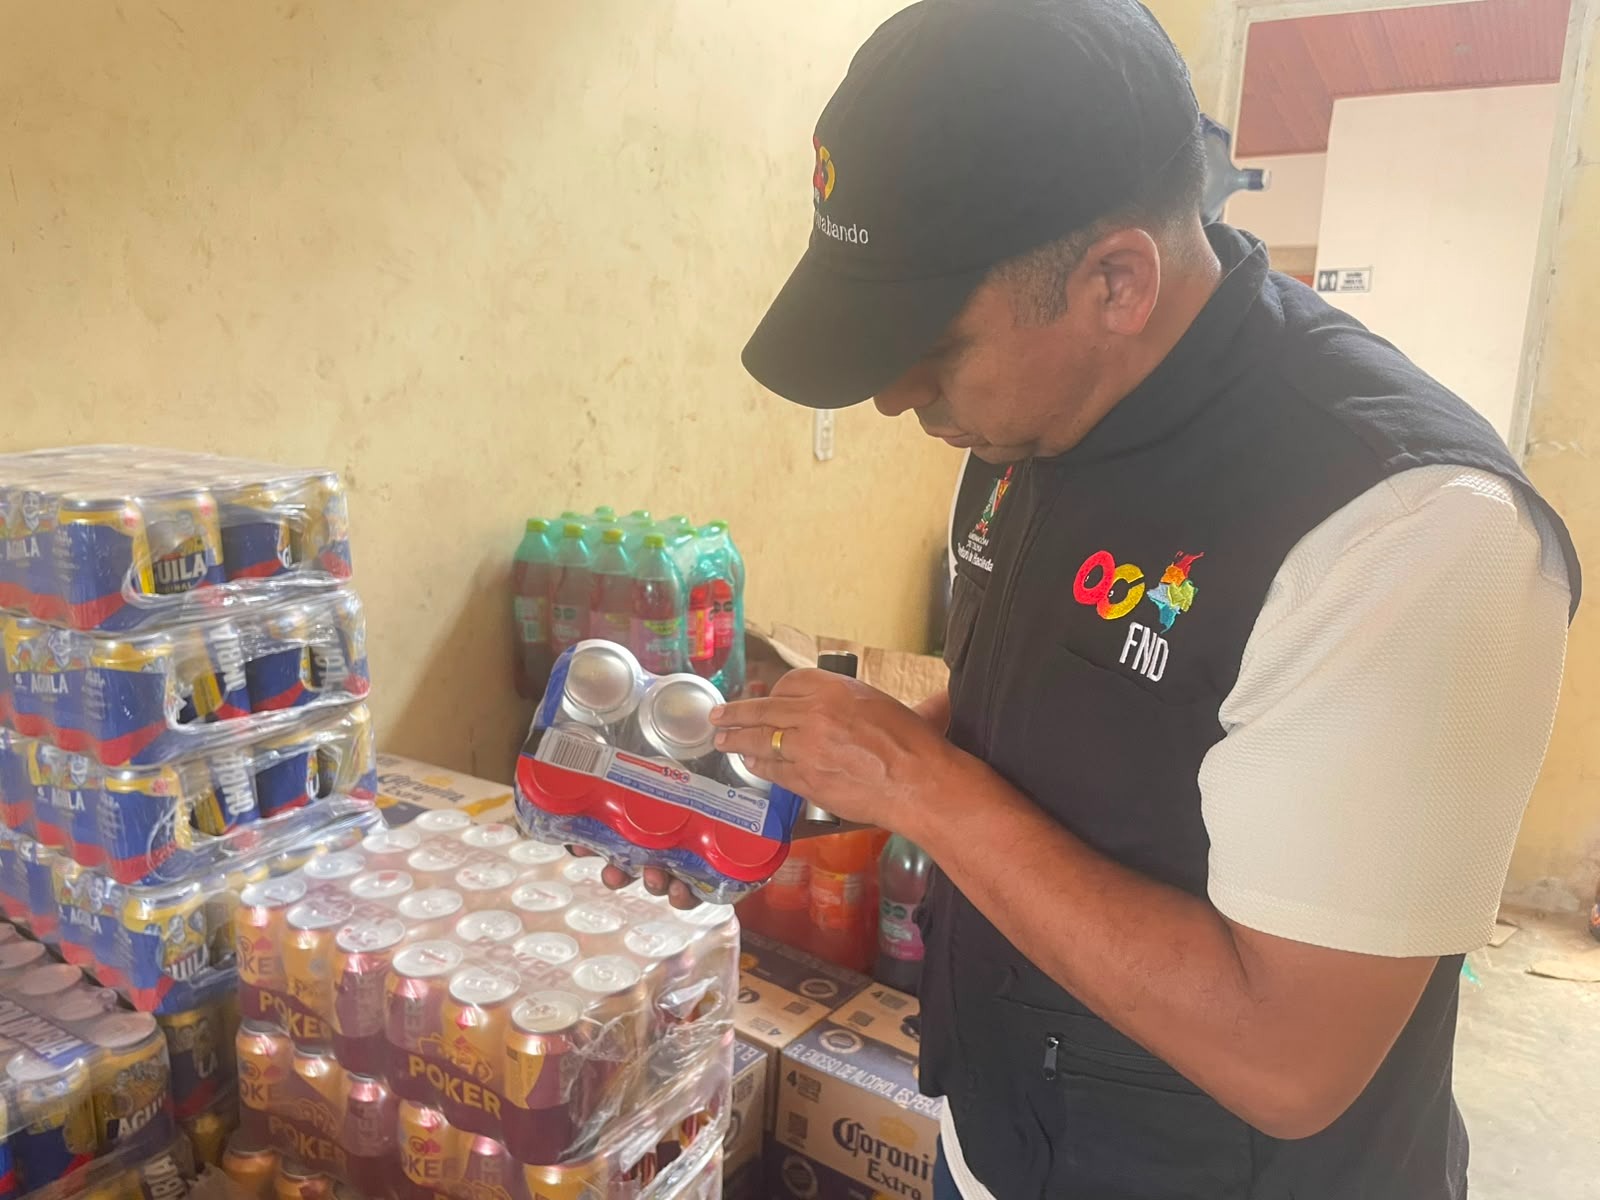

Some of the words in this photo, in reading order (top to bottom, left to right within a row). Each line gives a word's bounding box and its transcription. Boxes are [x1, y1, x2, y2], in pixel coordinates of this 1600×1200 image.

[1119, 621, 1169, 682] FND
[408, 1054, 502, 1121] POKER
[789, 1043, 806, 1061] EL
[839, 1061, 858, 1080] DE
